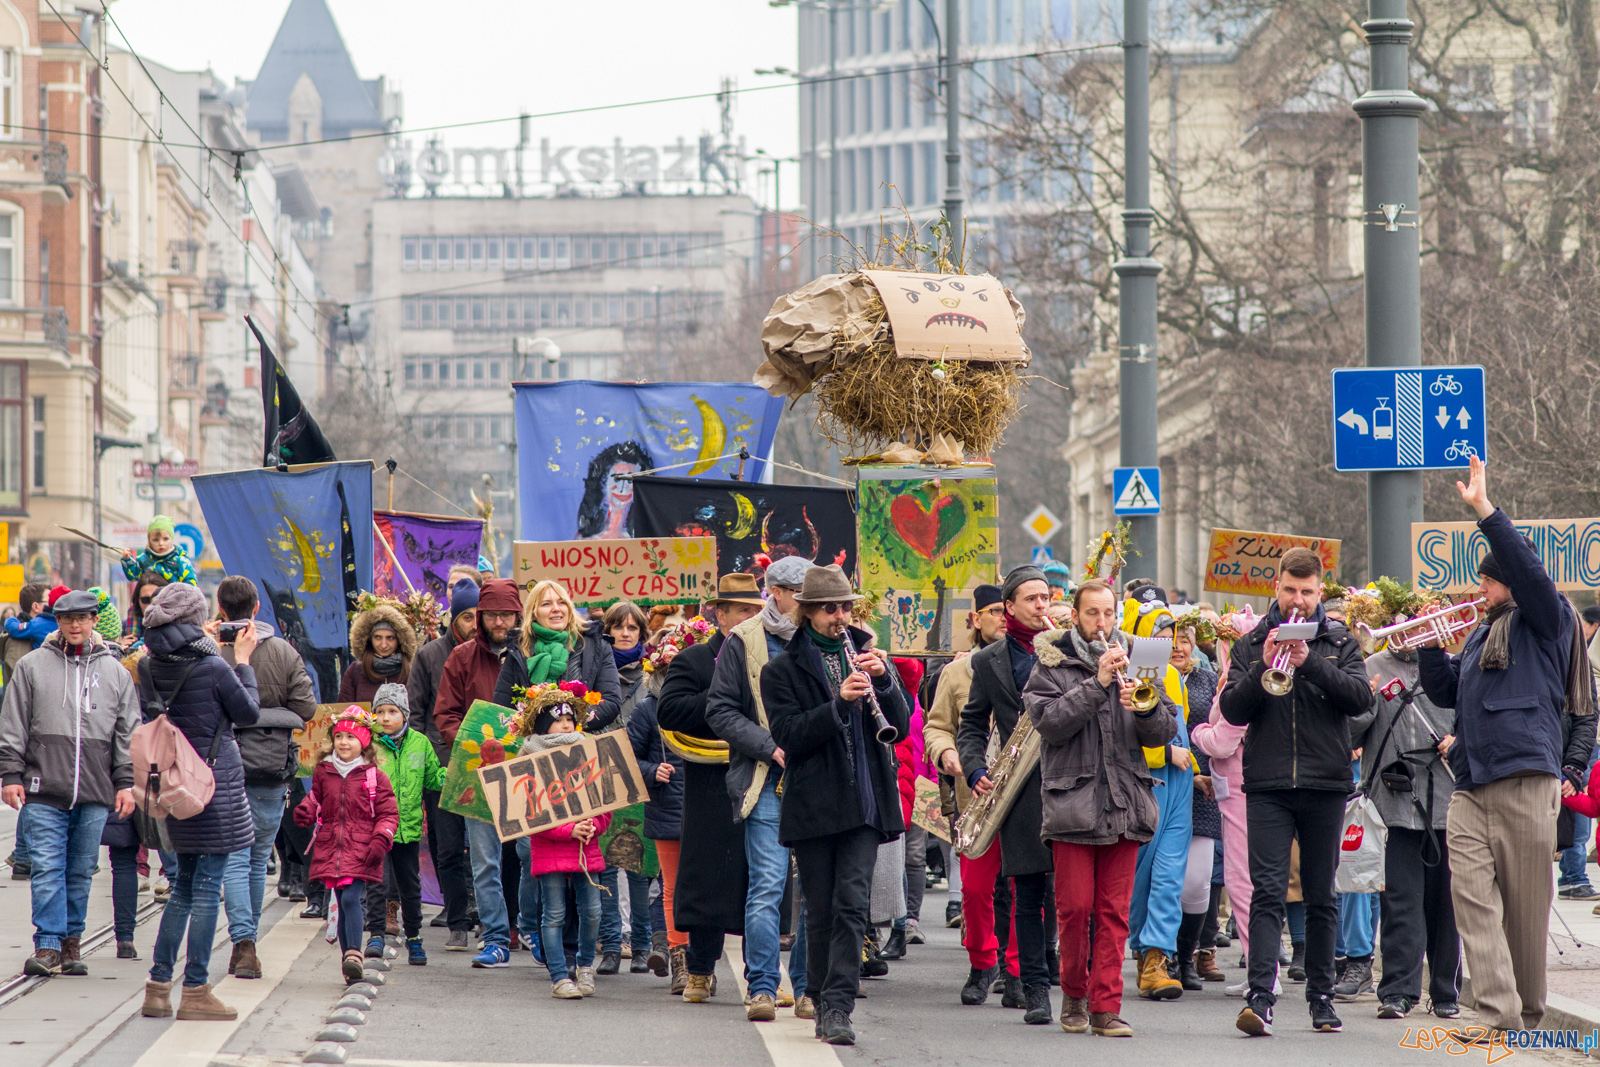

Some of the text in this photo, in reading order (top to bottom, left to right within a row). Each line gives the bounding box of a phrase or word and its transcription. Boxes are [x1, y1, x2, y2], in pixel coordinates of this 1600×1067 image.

[943, 534, 993, 569] Wiosna!
[1515, 522, 1600, 587] IMO
[558, 571, 699, 600] JUŻ CZAS!!!
[1250, 566, 1275, 579] DO
[513, 756, 605, 820] Precz
